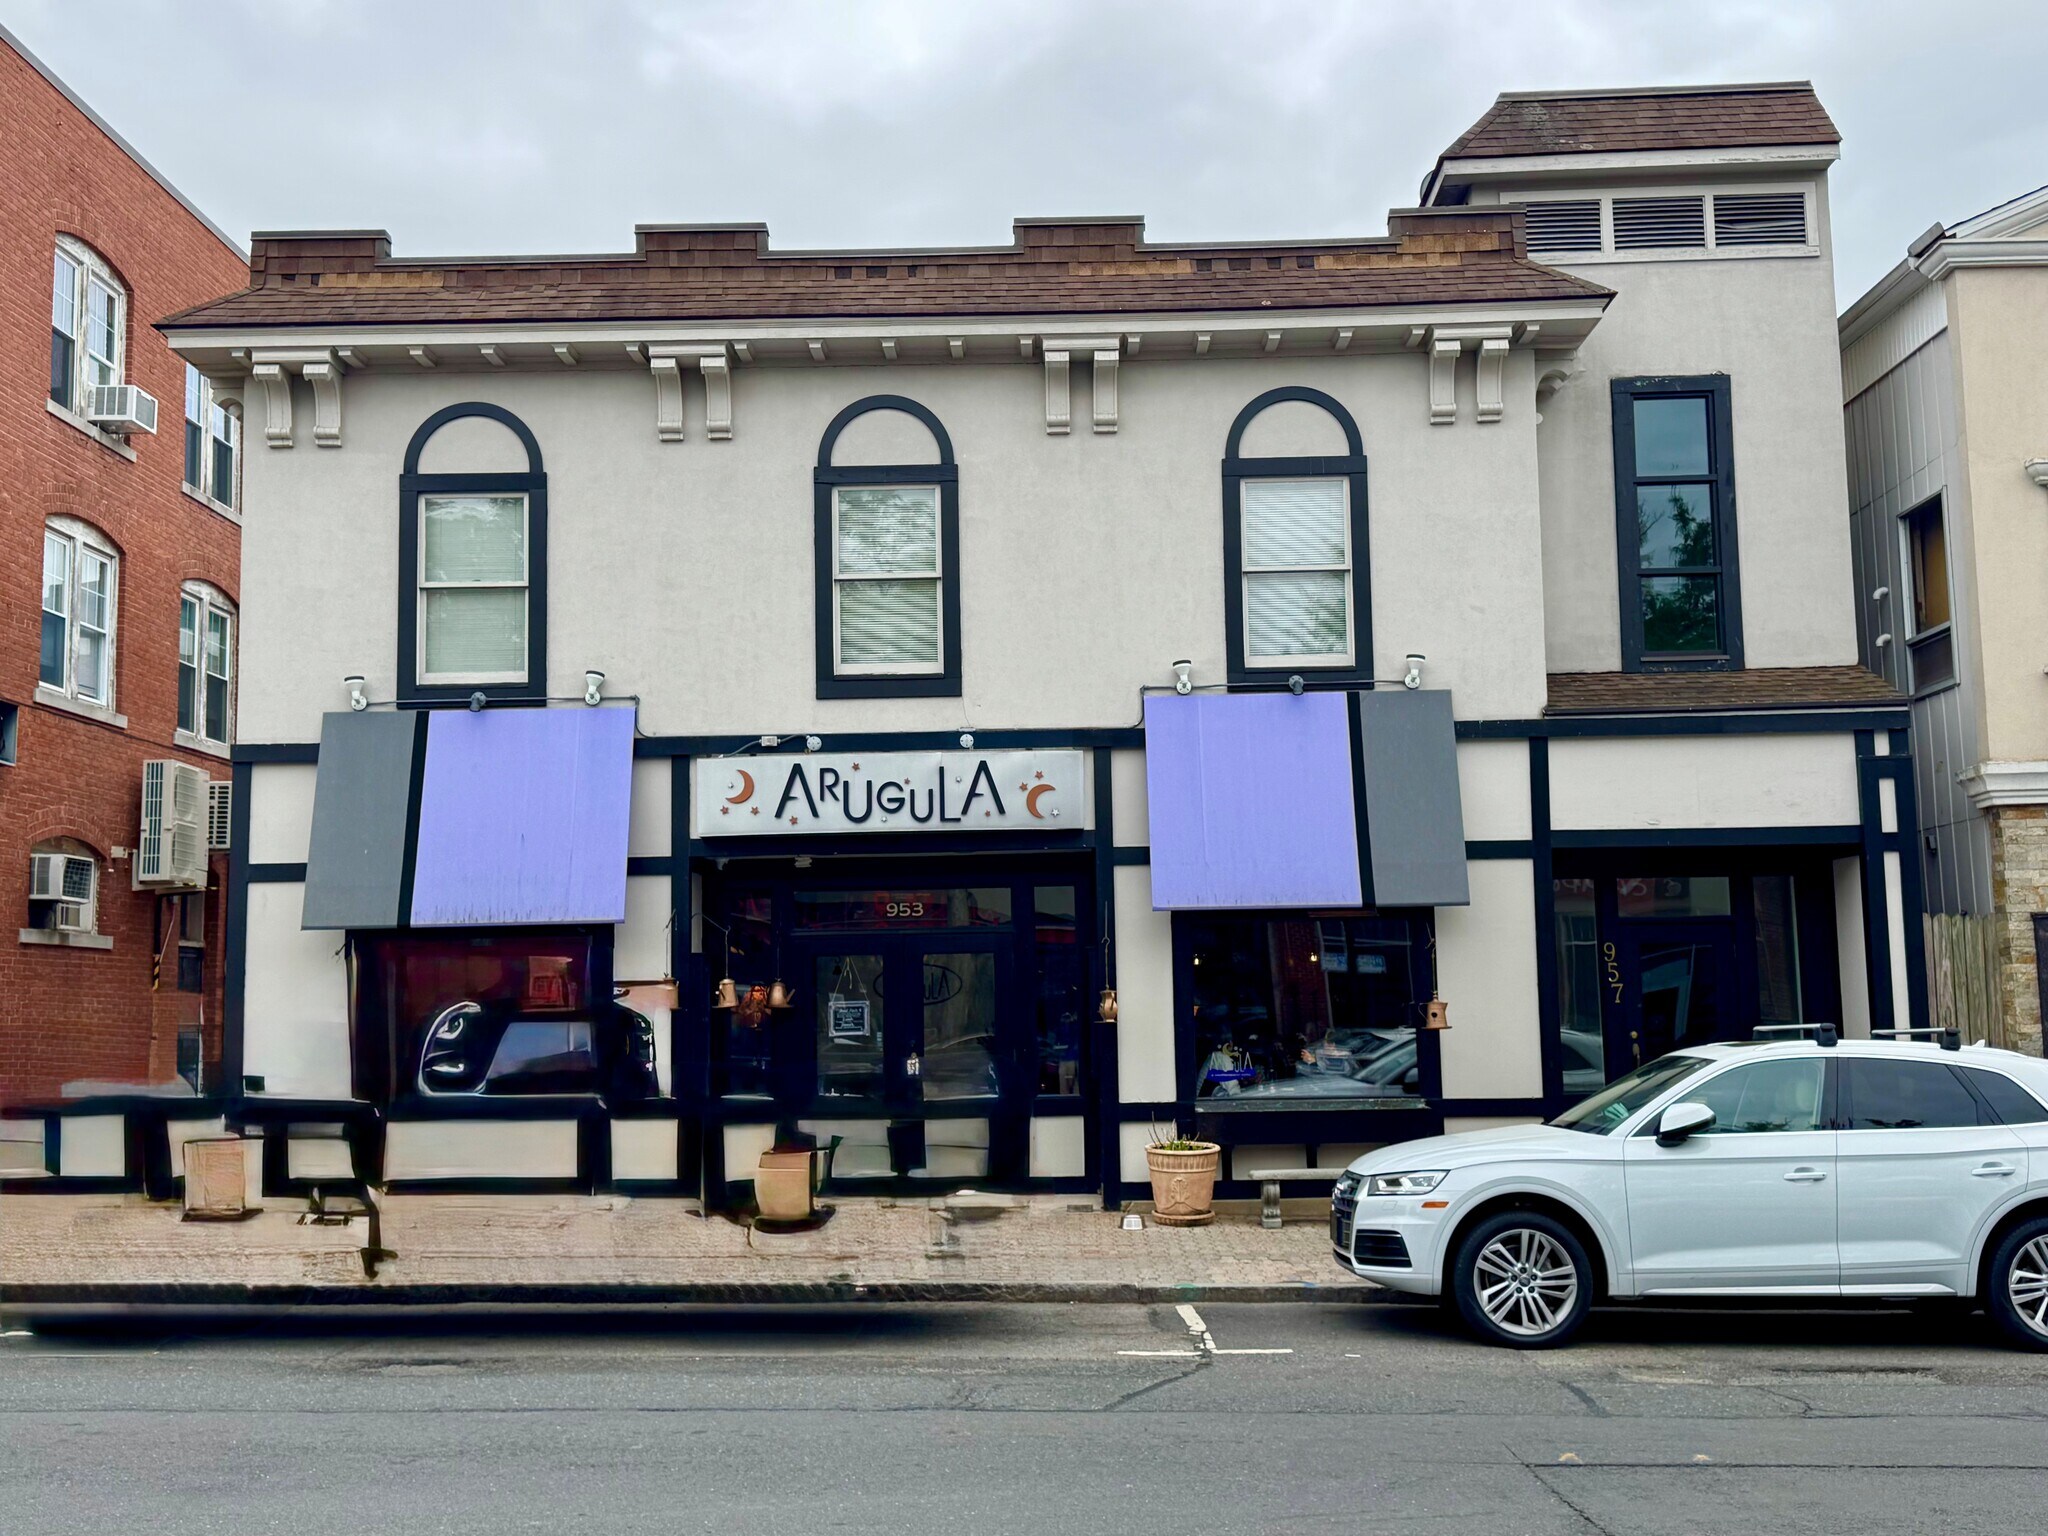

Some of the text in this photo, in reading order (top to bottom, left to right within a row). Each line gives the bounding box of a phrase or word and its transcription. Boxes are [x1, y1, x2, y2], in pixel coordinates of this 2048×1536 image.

[775, 760, 1005, 823] ARUGULA
[885, 902, 925, 917] 953
[1603, 942, 1624, 1003] 957
